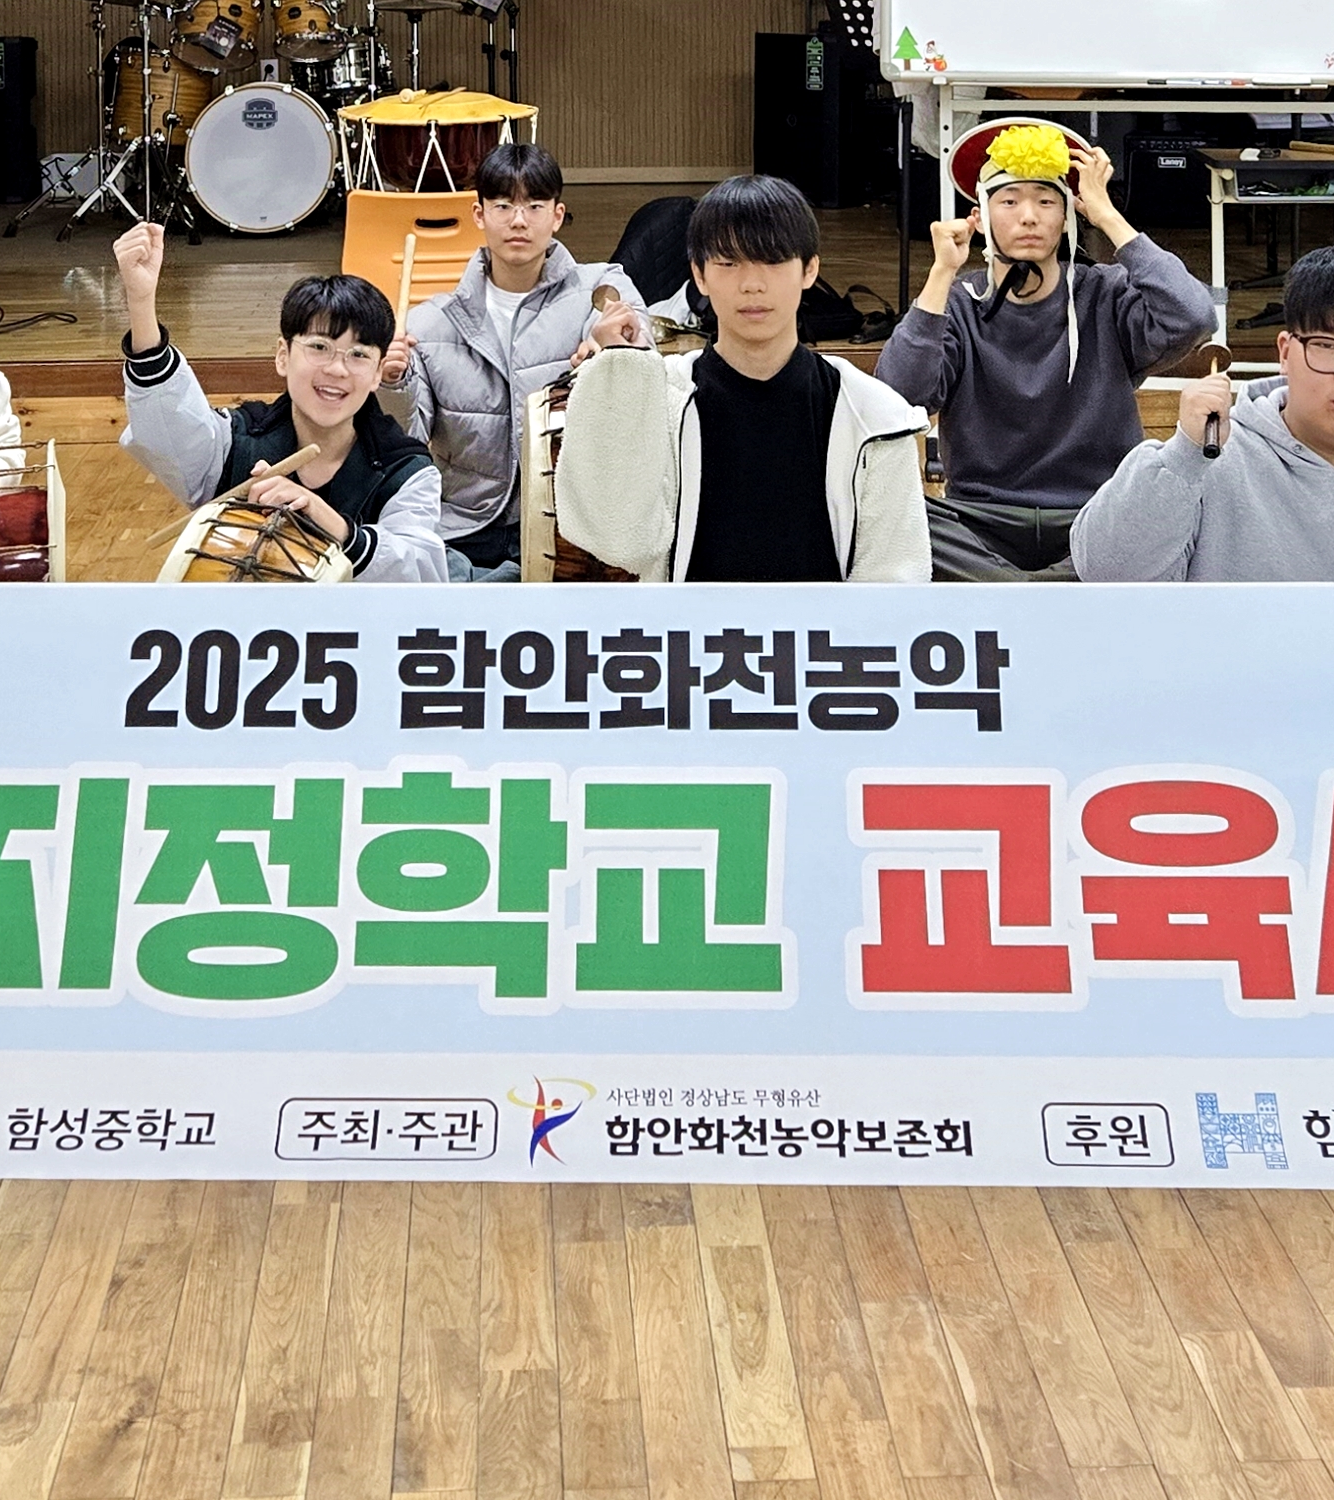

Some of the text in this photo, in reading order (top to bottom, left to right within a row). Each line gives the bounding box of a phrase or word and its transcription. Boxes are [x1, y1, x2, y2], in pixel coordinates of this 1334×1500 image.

[246, 112, 274, 120] MAPEX
[124, 627, 1010, 732] 2025 함안화천농악
[606, 1087, 821, 1108] 사단법인 경상남도 무형유산
[6, 1107, 217, 1152] 함성중학교
[605, 1115, 974, 1158] 함안화천농악보존회
[1065, 1113, 1152, 1158] 후원
